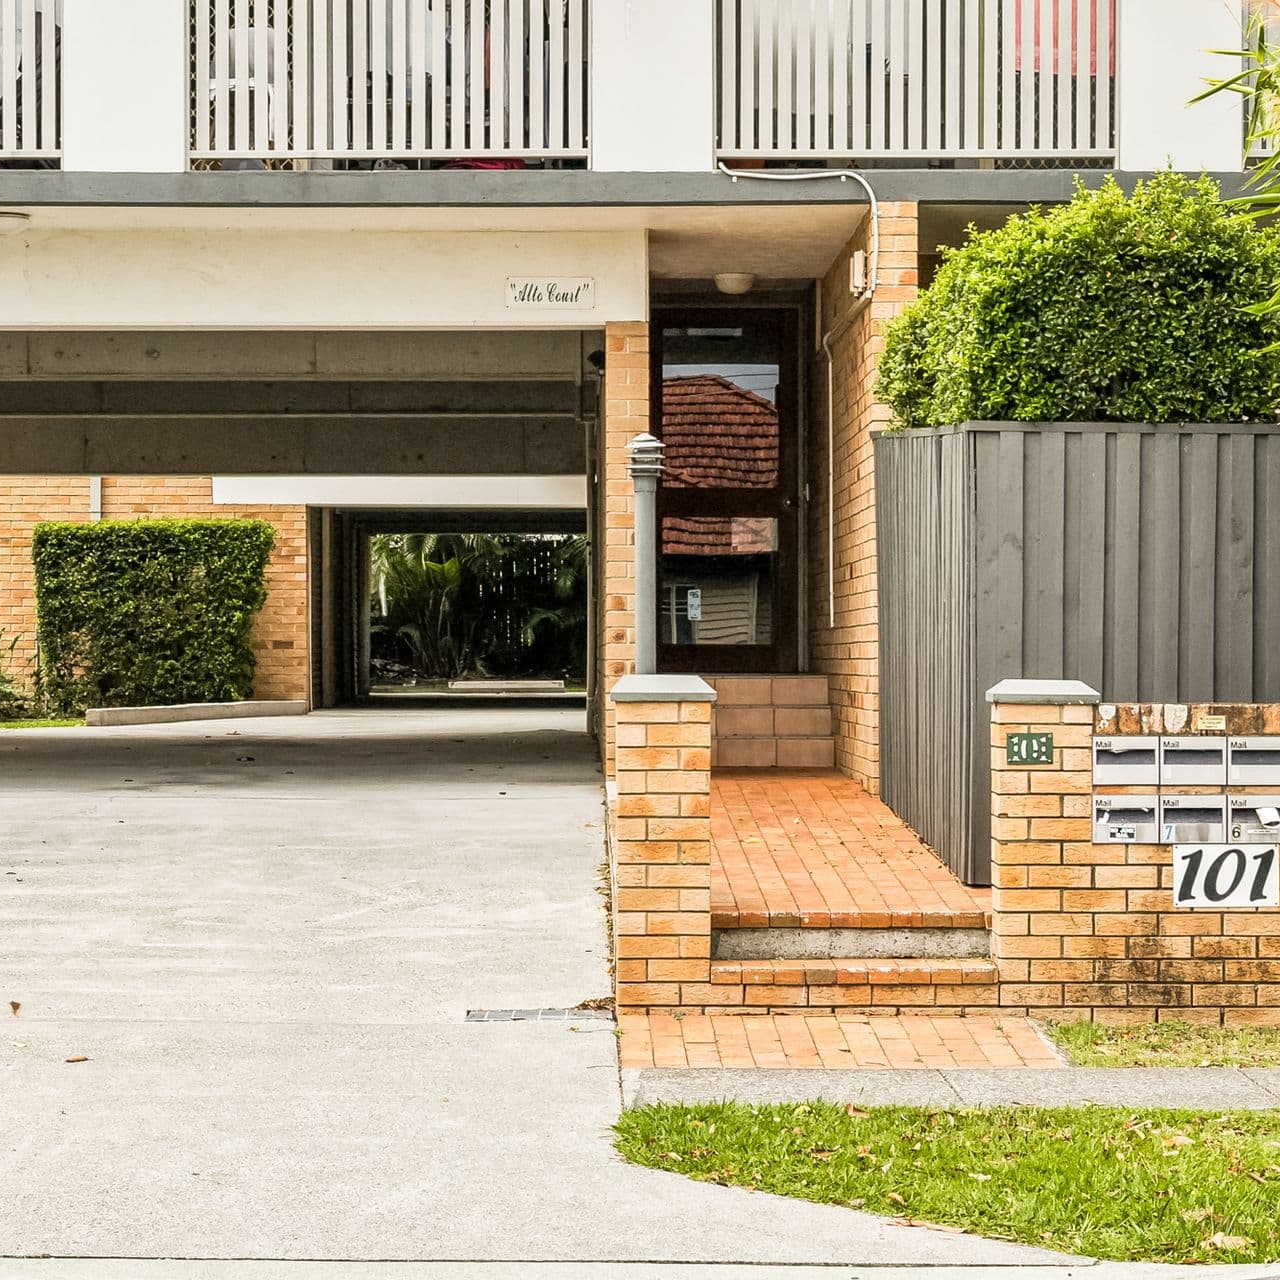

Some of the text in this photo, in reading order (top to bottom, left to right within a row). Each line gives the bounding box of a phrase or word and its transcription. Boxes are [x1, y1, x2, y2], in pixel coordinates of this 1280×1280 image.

[1095, 740, 1112, 748] Mail
[1163, 740, 1180, 748] Mail
[1230, 741, 1248, 749] Mail
[1095, 799, 1112, 807] Mail
[1162, 799, 1180, 807] Mail
[1231, 799, 1247, 807] Mail
[1165, 825, 1173, 840] 7
[1232, 826, 1240, 839] 6
[1178, 848, 1276, 902] 101
